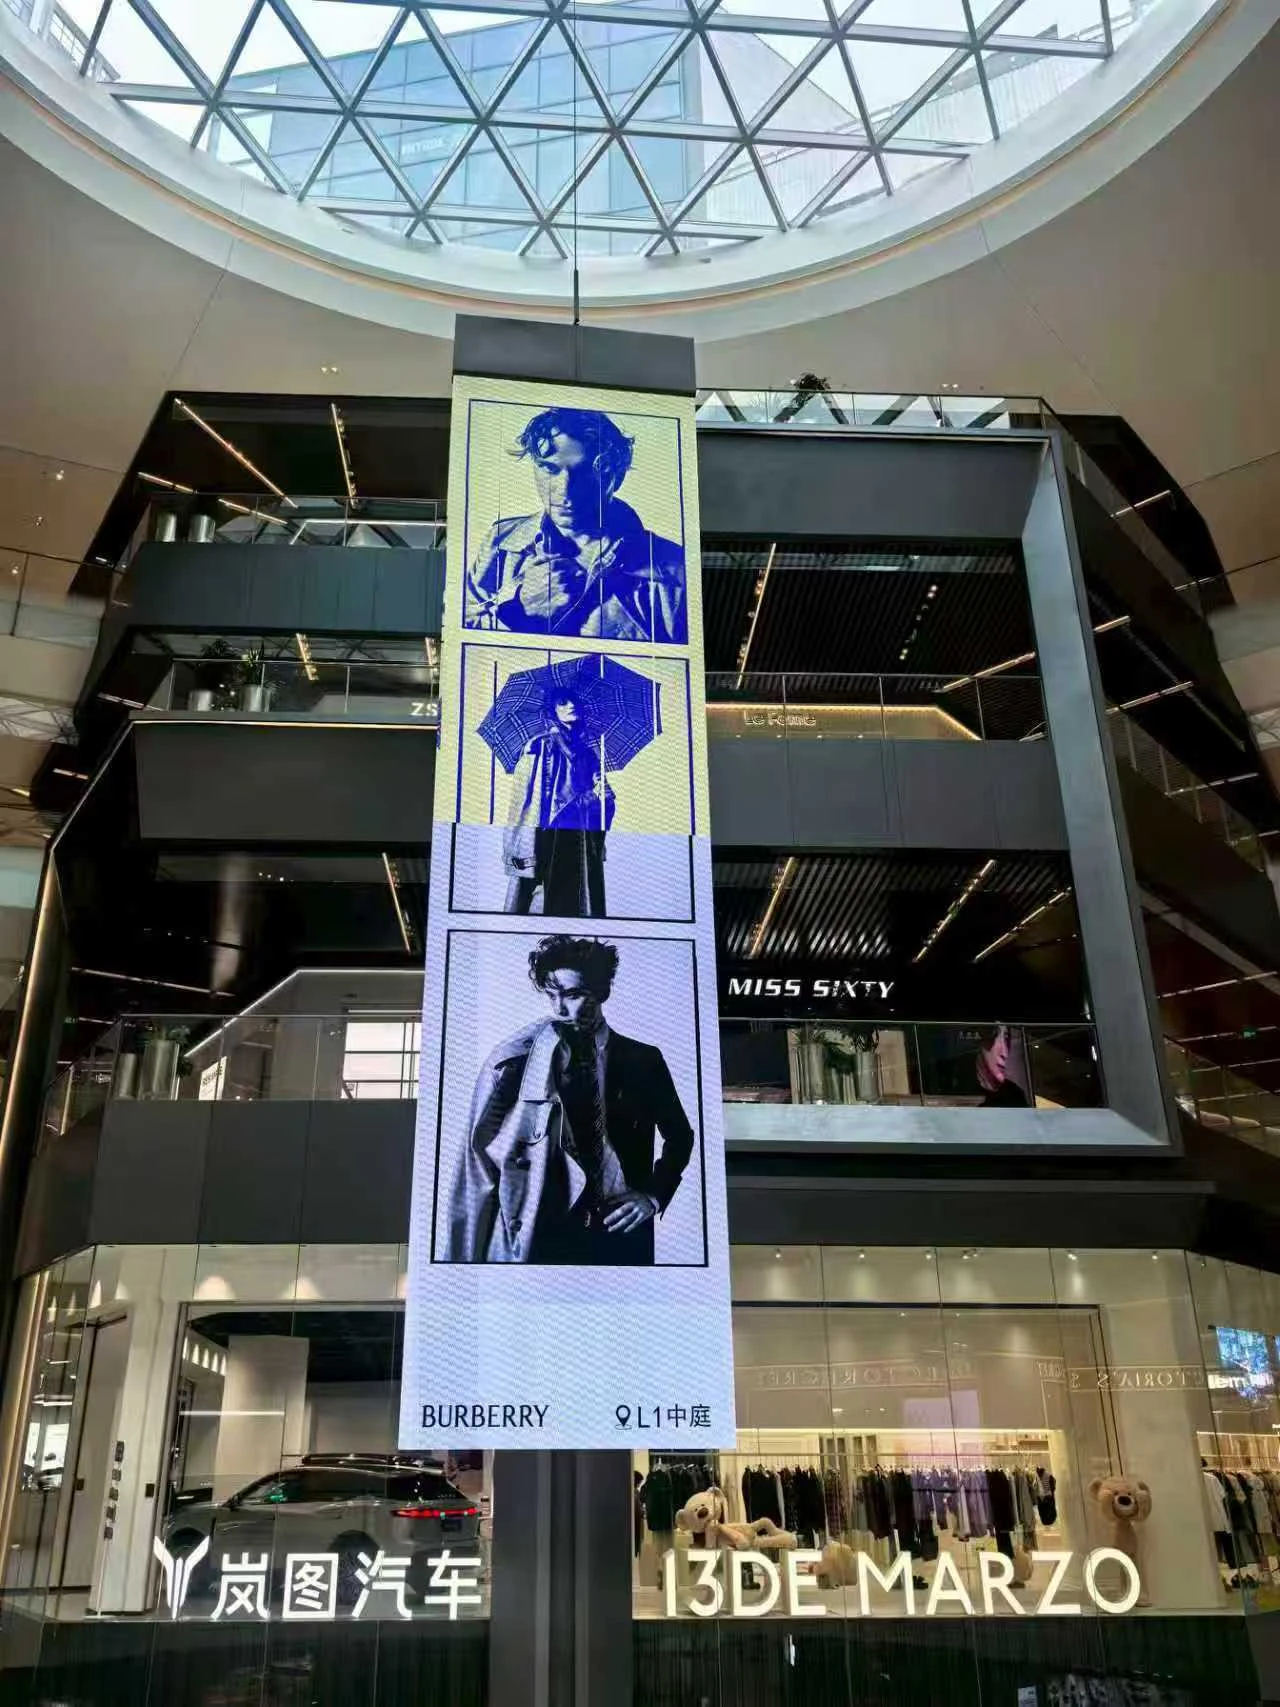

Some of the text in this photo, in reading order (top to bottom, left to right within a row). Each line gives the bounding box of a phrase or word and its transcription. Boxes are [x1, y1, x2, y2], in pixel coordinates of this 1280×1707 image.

[728, 978, 895, 998] MISS SIXTY
[421, 1404, 550, 1429] BURBERRY
[638, 1403, 712, 1429] L1中庭
[210, 1549, 482, 1621] 岚图汽车
[664, 1547, 1141, 1617] 13DE MARZO
